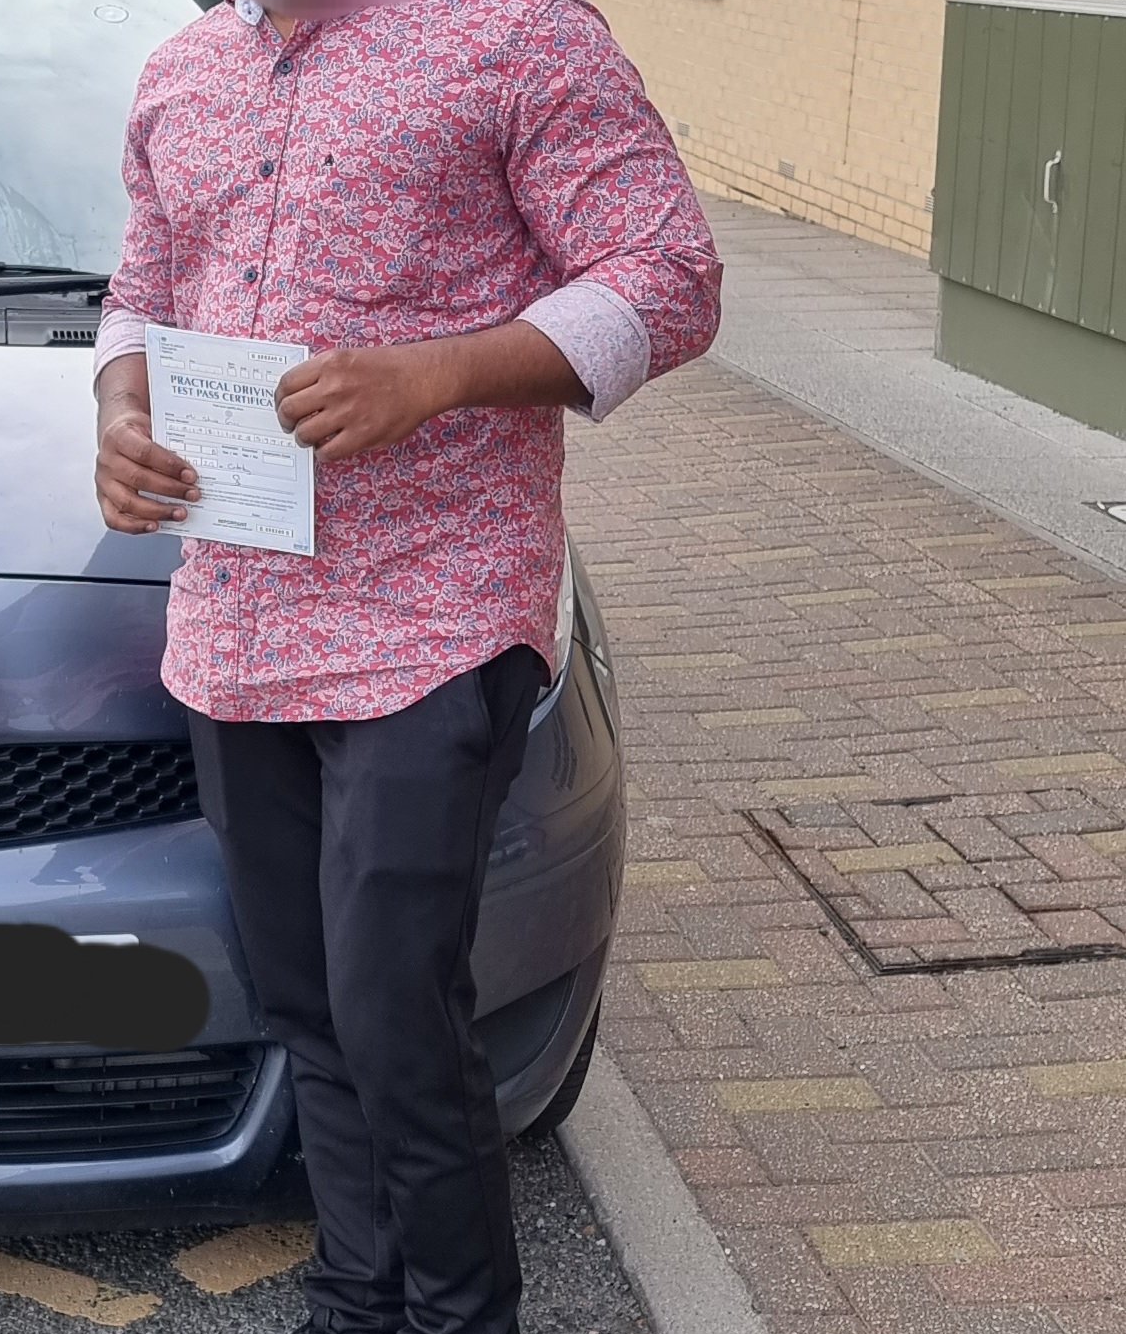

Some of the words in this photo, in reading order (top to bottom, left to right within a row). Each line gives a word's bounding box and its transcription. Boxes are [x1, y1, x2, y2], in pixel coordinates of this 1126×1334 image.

[170, 374, 230, 392] PRACTICAL
[233, 384, 274, 398] DRIVIN
[172, 385, 194, 396] TEST
[196, 387, 220, 400] PASS
[222, 392, 274, 408] CERTIFICA
